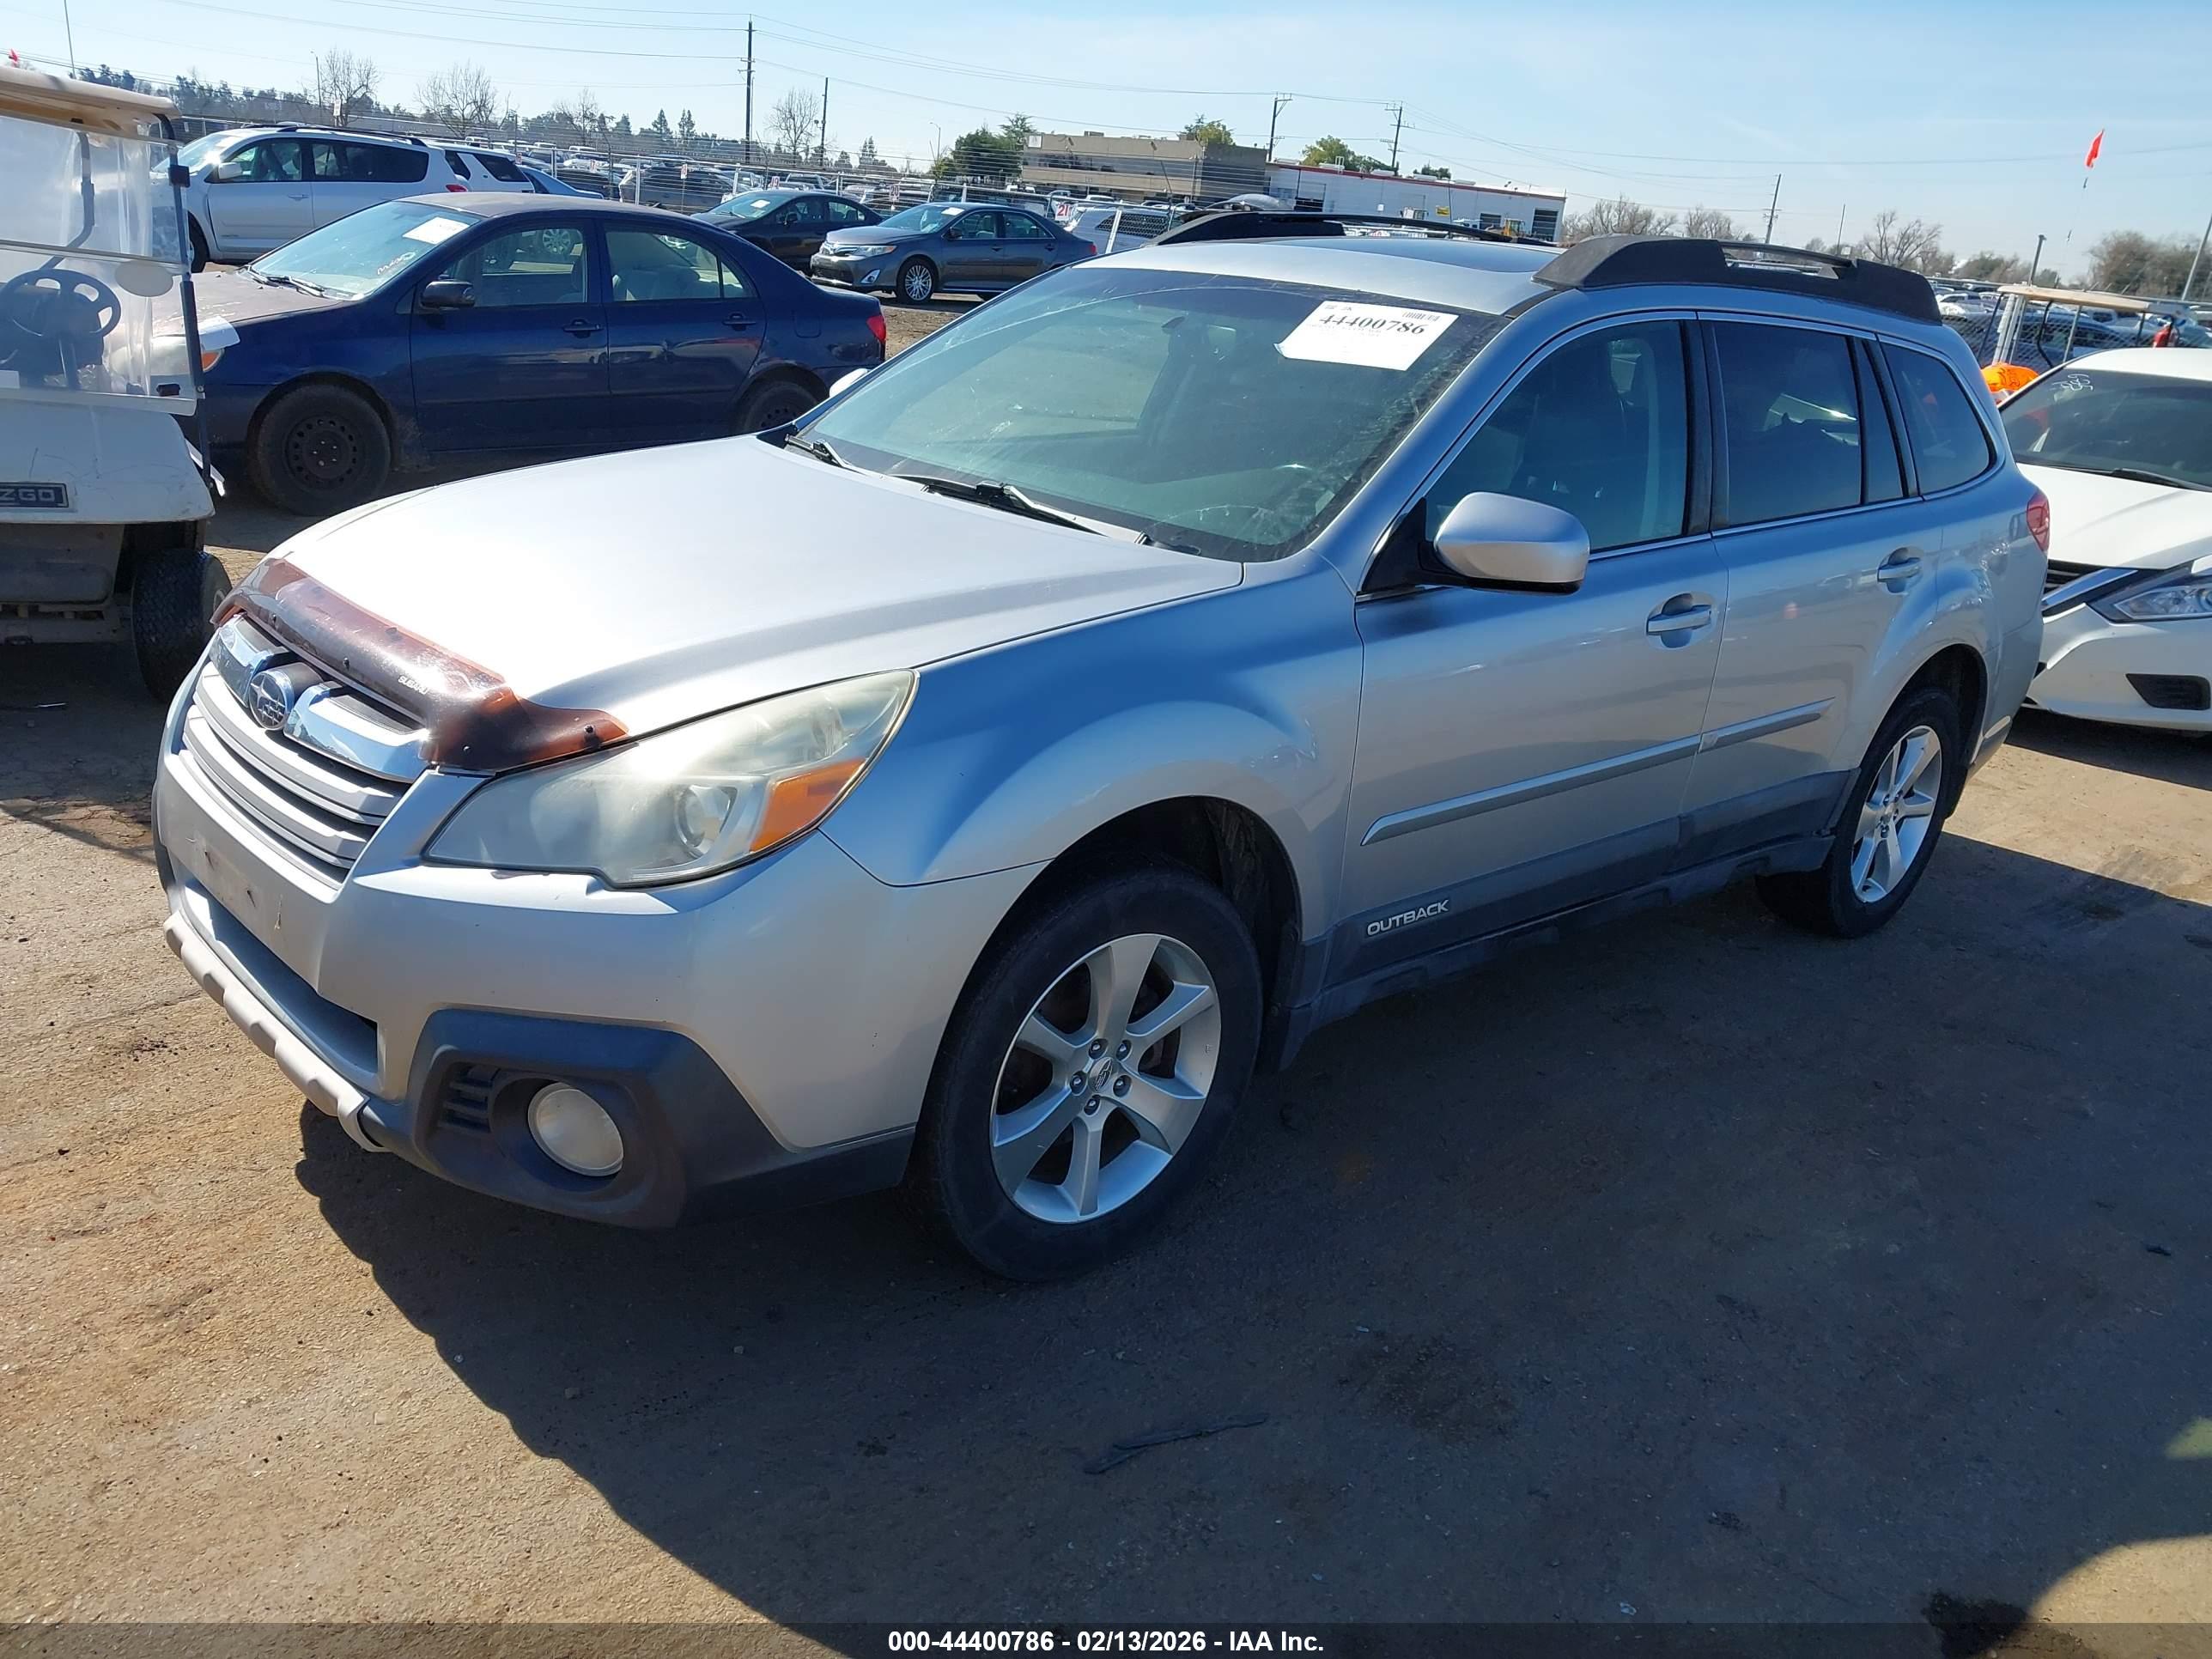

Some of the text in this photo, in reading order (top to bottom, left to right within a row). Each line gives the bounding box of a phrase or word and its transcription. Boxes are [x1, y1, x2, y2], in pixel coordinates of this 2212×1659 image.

[1056, 204, 1069, 216] 21
[1320, 314, 1429, 334] 44400786
[1367, 899, 1449, 936] OUTBACK
